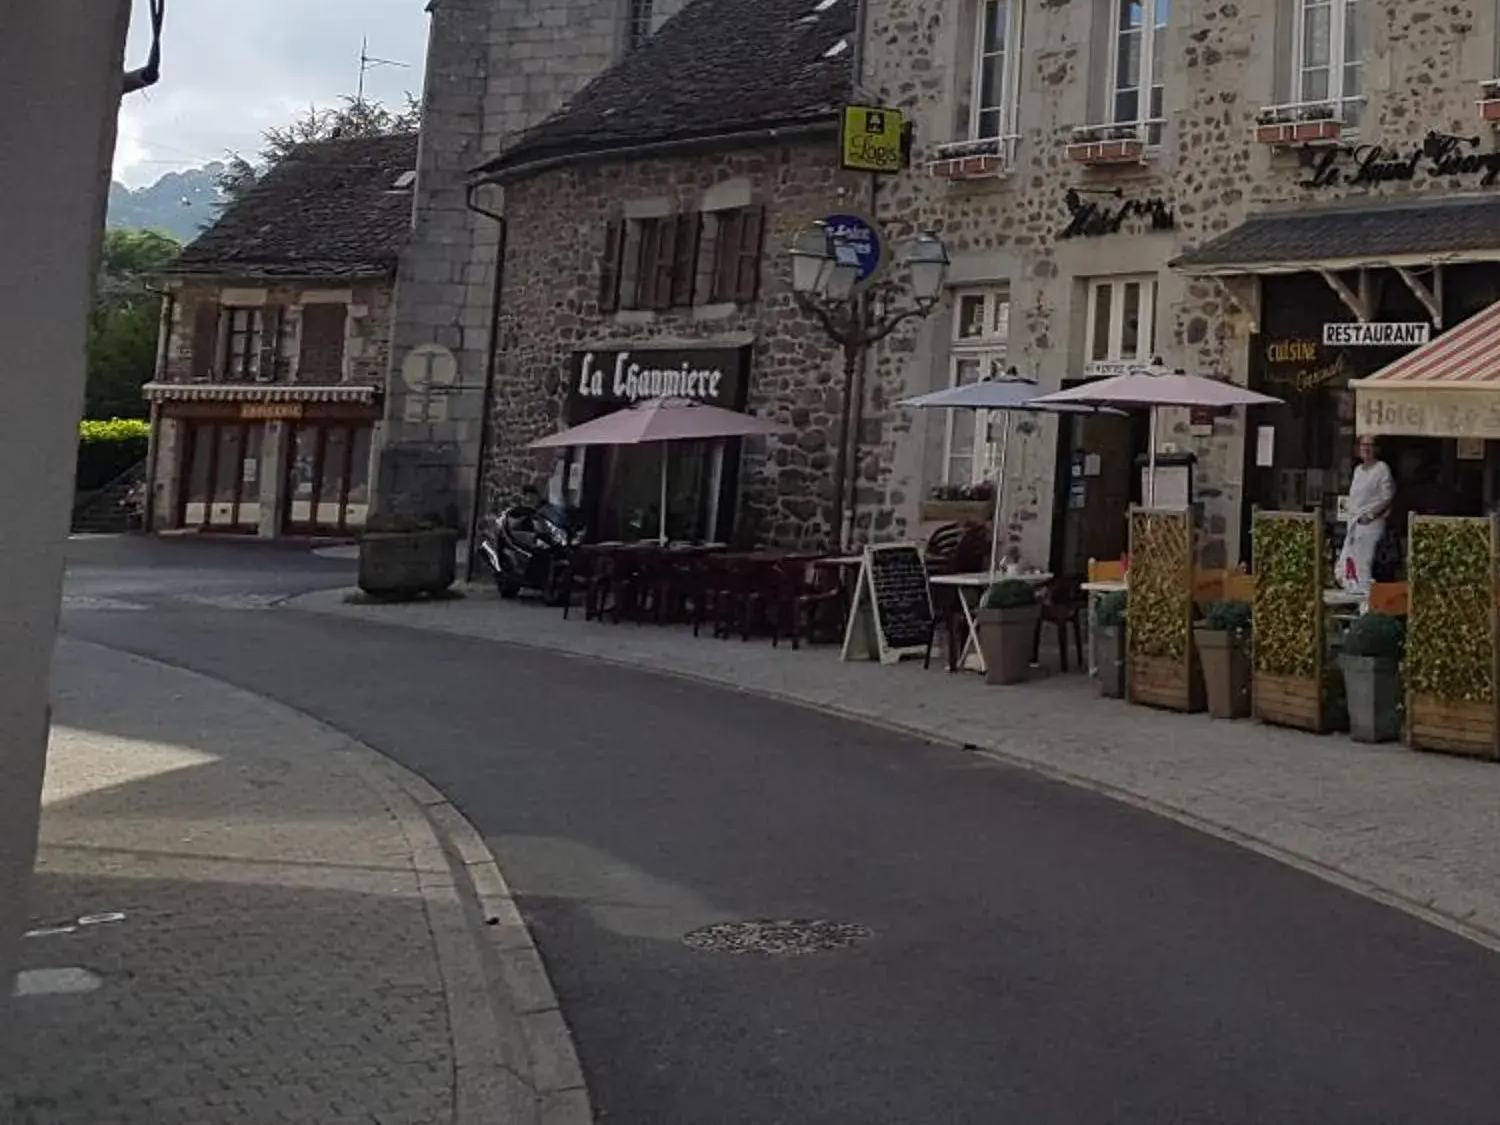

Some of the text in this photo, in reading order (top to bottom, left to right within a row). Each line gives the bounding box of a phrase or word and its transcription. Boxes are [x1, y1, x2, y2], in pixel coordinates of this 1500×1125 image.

[848, 133, 897, 167] Logis
[1327, 325, 1425, 343] RESTAURANT
[579, 352, 722, 402] La Chaumiere
